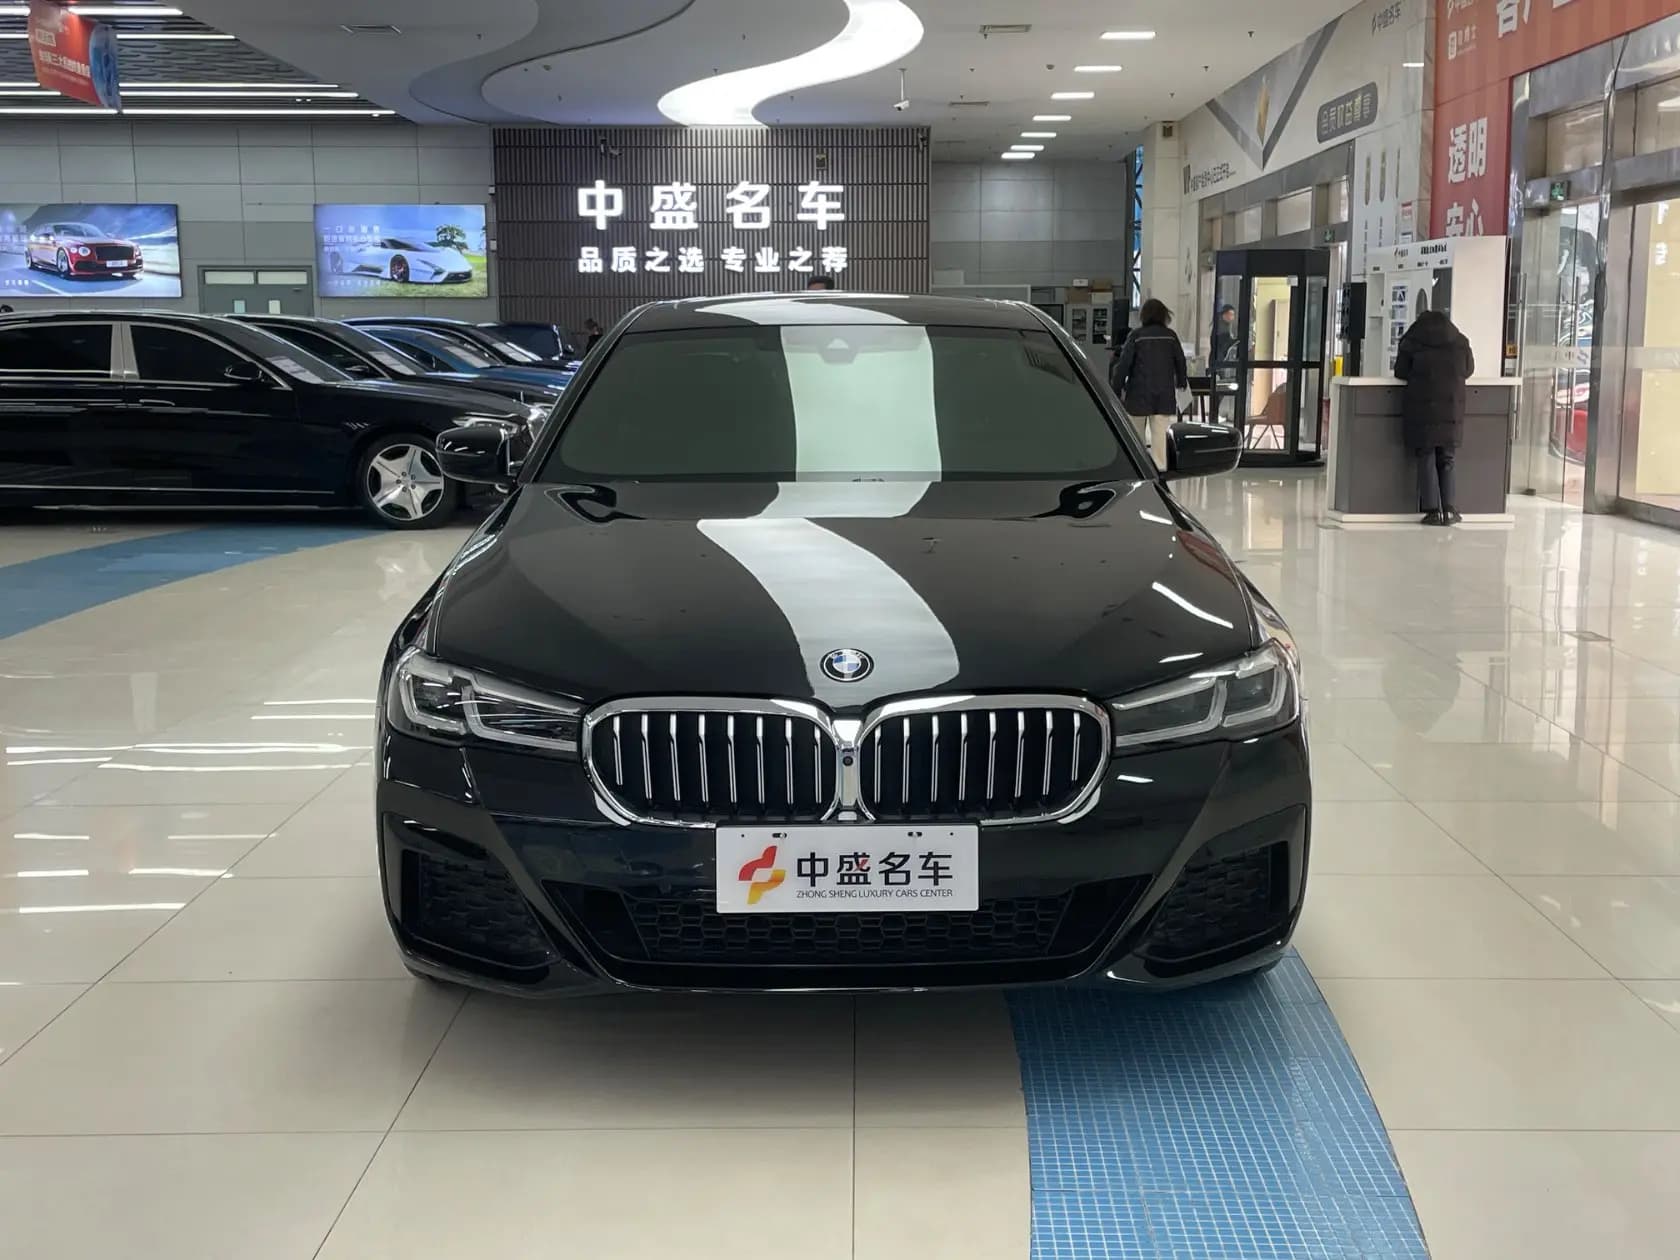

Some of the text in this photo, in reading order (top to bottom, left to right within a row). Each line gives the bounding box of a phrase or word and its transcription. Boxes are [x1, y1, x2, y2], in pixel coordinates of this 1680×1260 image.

[1448, 117, 1487, 183] 透明
[577, 180, 846, 230] 中盛名车
[578, 246, 848, 273] 品质之选 专业之荐
[797, 851, 953, 887] 中盛名车
[796, 888, 953, 899] ZHONG SHENG LUXURY CARS CENTER
